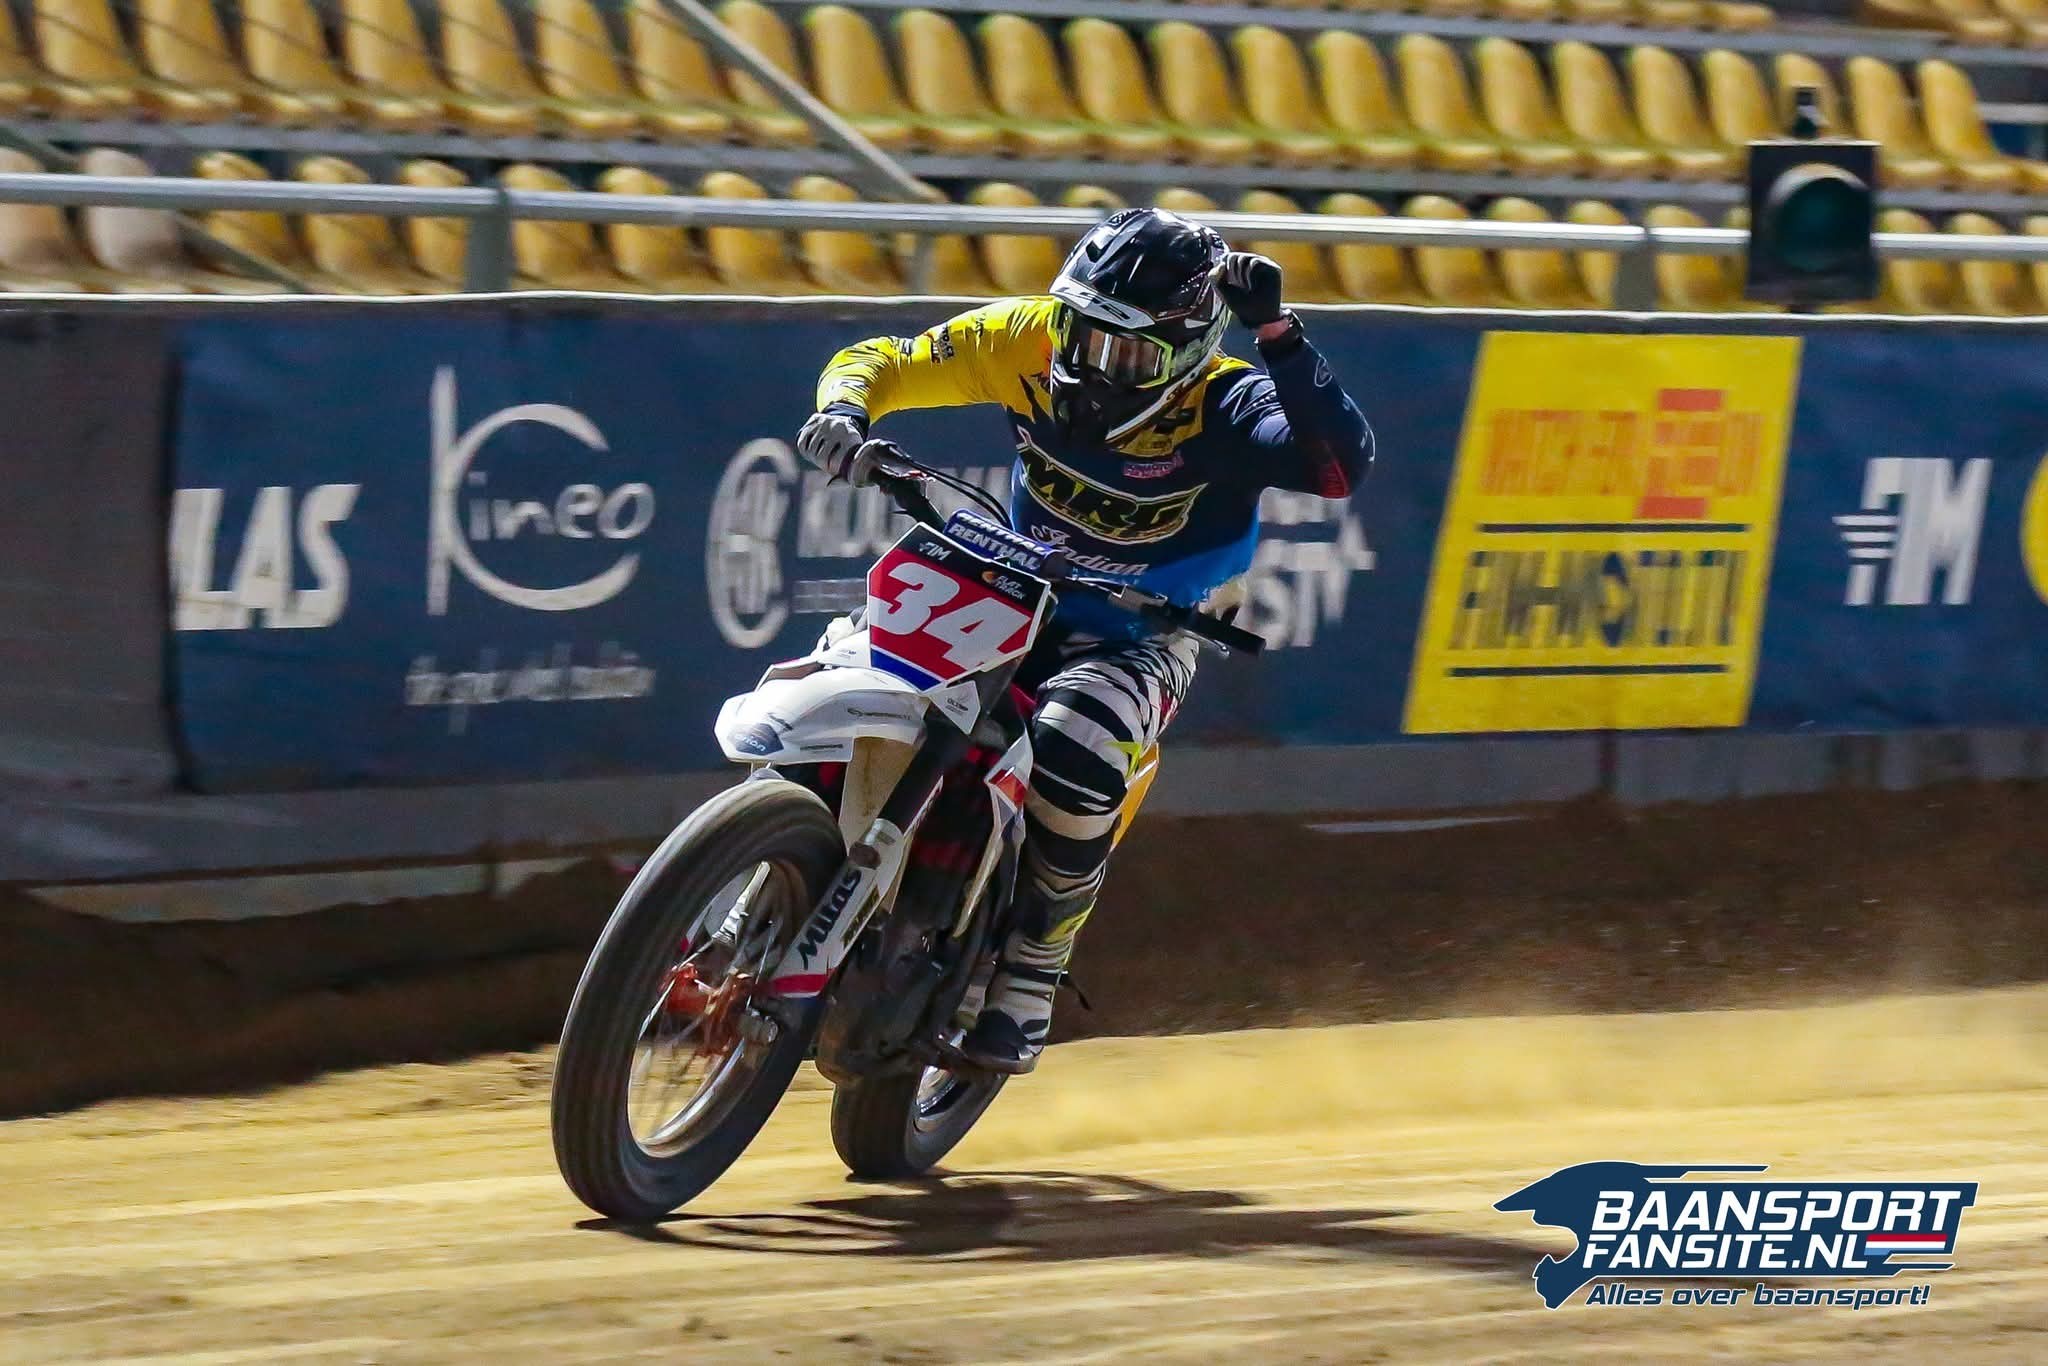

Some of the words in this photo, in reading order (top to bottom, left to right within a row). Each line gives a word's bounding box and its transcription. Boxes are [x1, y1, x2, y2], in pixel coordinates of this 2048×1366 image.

[427, 364, 655, 612] Kineo
[949, 523, 1042, 571] RENTHAL
[1031, 524, 1150, 576] Indian
[870, 562, 1032, 671] 34
